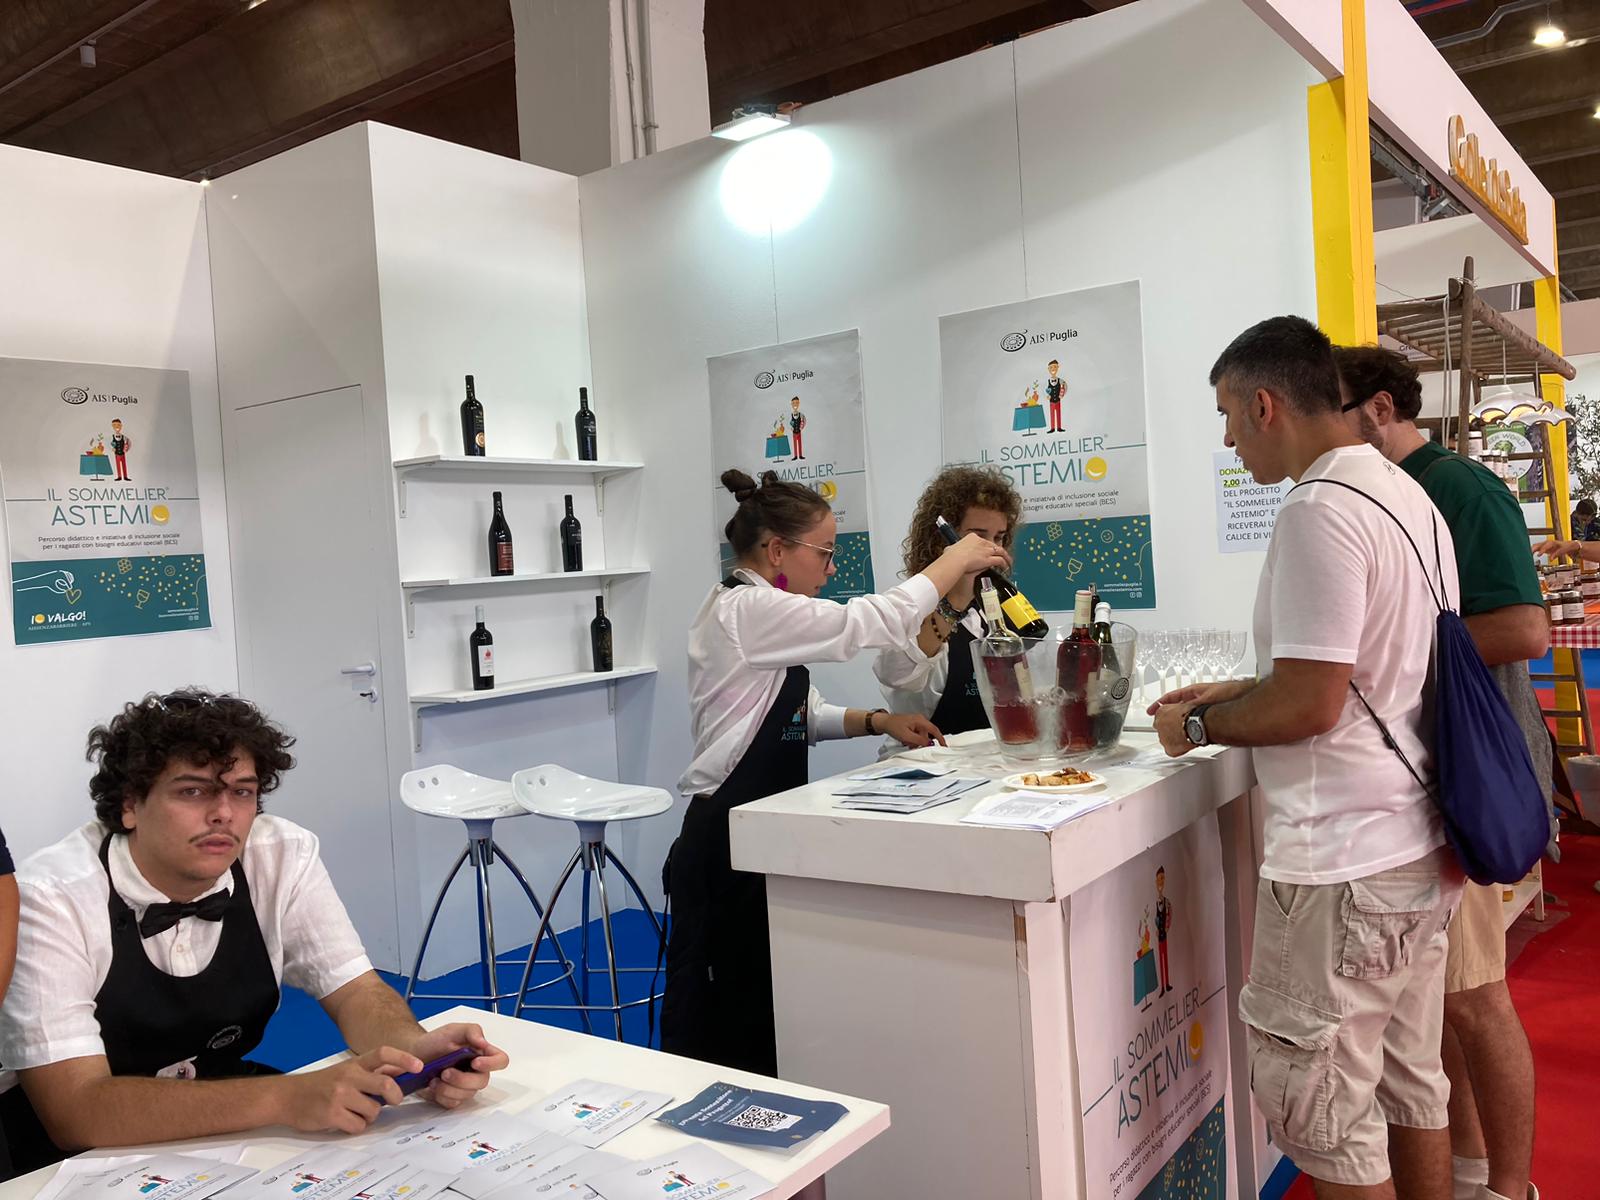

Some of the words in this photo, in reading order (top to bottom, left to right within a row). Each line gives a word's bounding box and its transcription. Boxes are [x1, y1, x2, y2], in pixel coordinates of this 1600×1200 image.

[1030, 334, 1045, 345] AIS
[1050, 329, 1078, 341] Puglia
[777, 374, 788, 383] AIS
[792, 370, 814, 380] Puglia
[92, 394, 107, 402] AIS
[111, 395, 138, 405] Puglia
[981, 449, 994, 464] IL
[1000, 436, 1104, 462] SOMMELIER
[756, 463, 834, 485] SMMELIER
[47, 488, 62, 501] IL
[68, 487, 168, 502] SOMMELIER
[1030, 495, 1056, 503] iniziativa
[1057, 493, 1063, 501] di
[1064, 492, 1096, 501] inclusione
[1097, 489, 1120, 498] sociale
[1240, 486, 1281, 496] PROGETTO
[1045, 501, 1073, 510] educativi
[1075, 499, 1098, 508] speciali
[1099, 498, 1117, 507] (BES)
[1235, 497, 1281, 508] SOMMELIER
[1227, 521, 1266, 530] RICEVERAI
[1225, 532, 1251, 541] CALICE
[1263, 531, 1271, 539] VI
[47, 610, 87, 623] VALGO!
[1113, 1055, 1124, 1085] IL
[1127, 986, 1201, 1069] SOMMELIER
